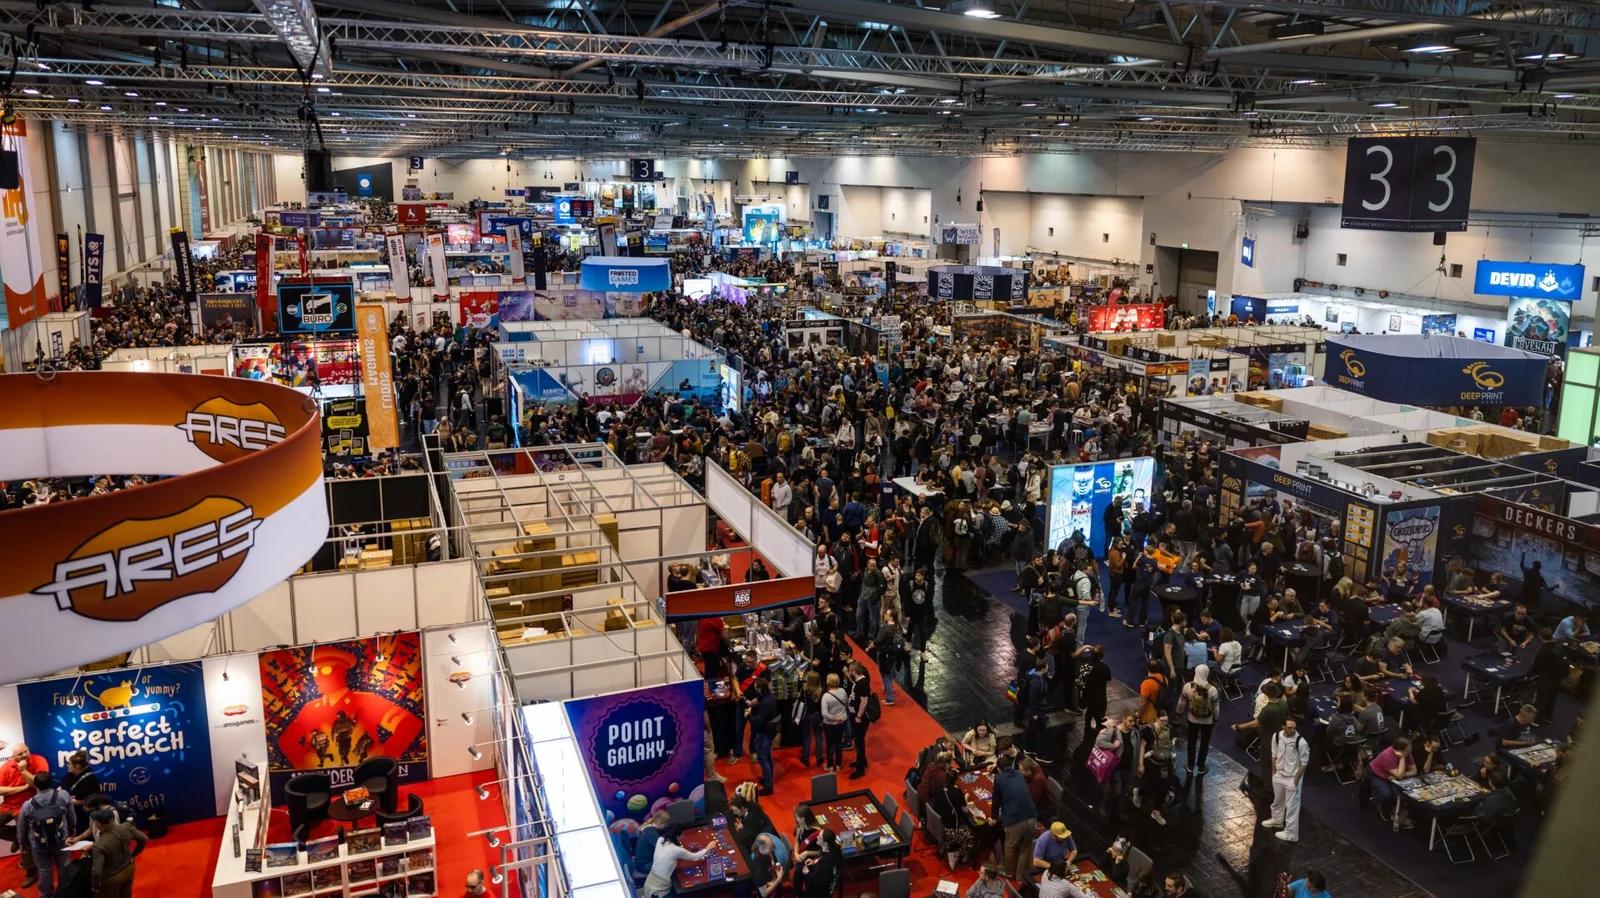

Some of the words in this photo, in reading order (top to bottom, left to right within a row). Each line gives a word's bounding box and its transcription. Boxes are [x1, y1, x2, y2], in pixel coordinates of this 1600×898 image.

[413, 157, 421, 169] 3
[640, 161, 650, 178] 3
[1362, 145, 1393, 211] 3
[1428, 145, 1457, 212] 3
[390, 239, 399, 257] SHOP
[1489, 271, 1537, 288] DEVIR
[303, 315, 333, 323] BURO
[1460, 391, 1481, 400] DEEP
[1481, 391, 1504, 400] PRINT
[1195, 415, 1211, 425] SHOP
[1273, 473, 1292, 486] DEEP
[1292, 480, 1313, 494] PRINT
[1505, 506, 1576, 540] DECKERS
[31, 506, 264, 610] ARES
[735, 593, 751, 603] AEG
[141, 674, 152, 684] or
[144, 682, 180, 698] yummy?
[70, 715, 171, 749] perfect
[608, 715, 665, 746] POINT
[607, 739, 665, 767] GALAXY
